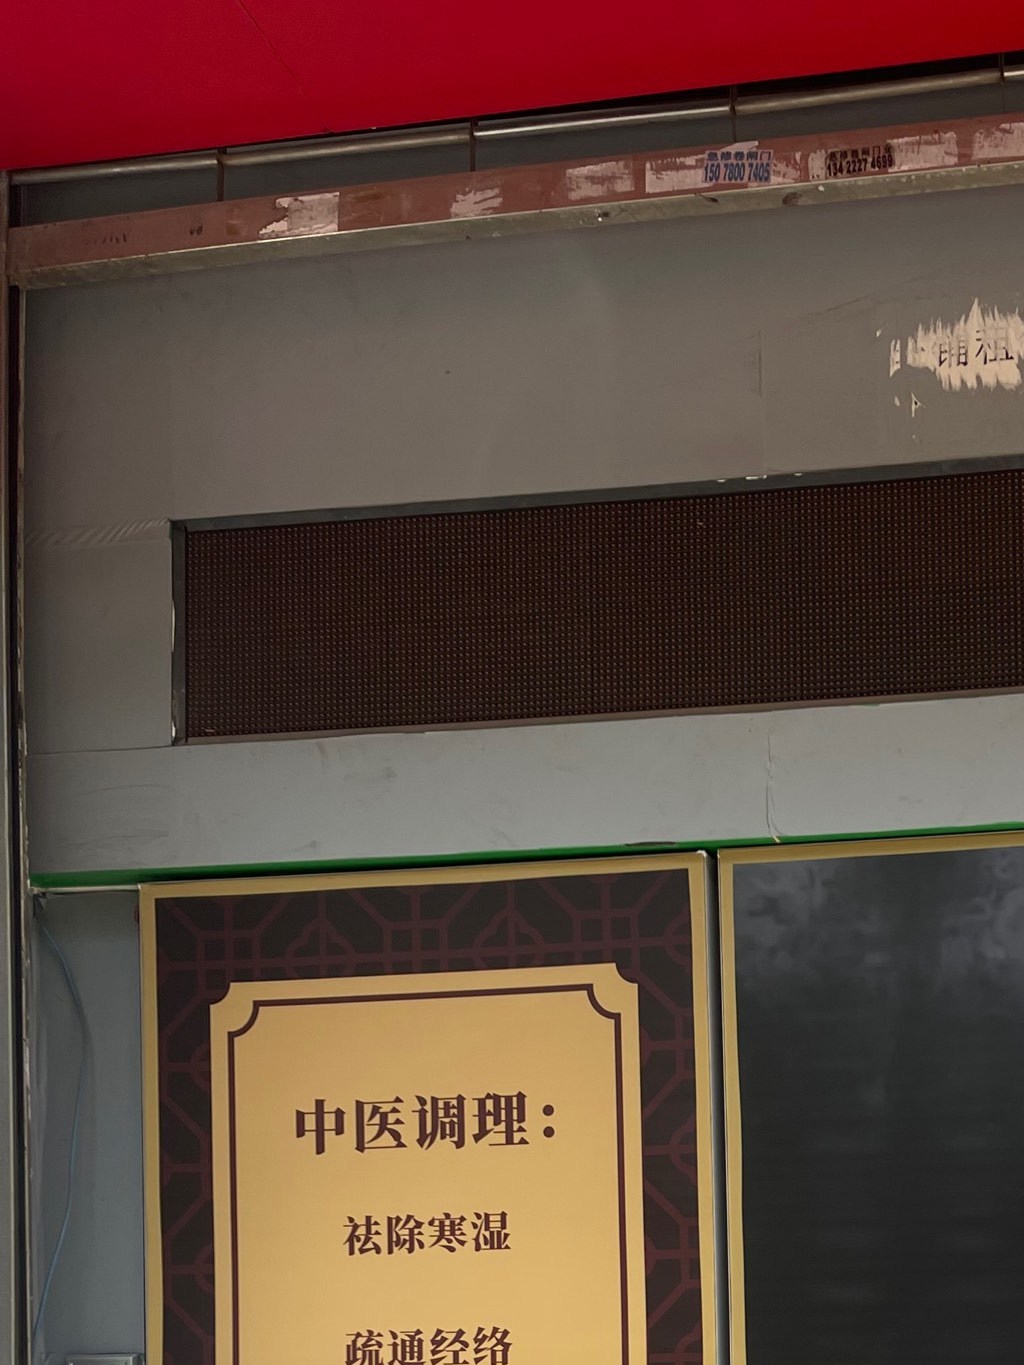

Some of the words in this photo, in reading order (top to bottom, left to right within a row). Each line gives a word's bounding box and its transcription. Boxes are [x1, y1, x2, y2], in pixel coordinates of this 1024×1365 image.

[294, 1091, 555, 1156] 中医调理：
[342, 1210, 512, 1256] 祛除寒湿
